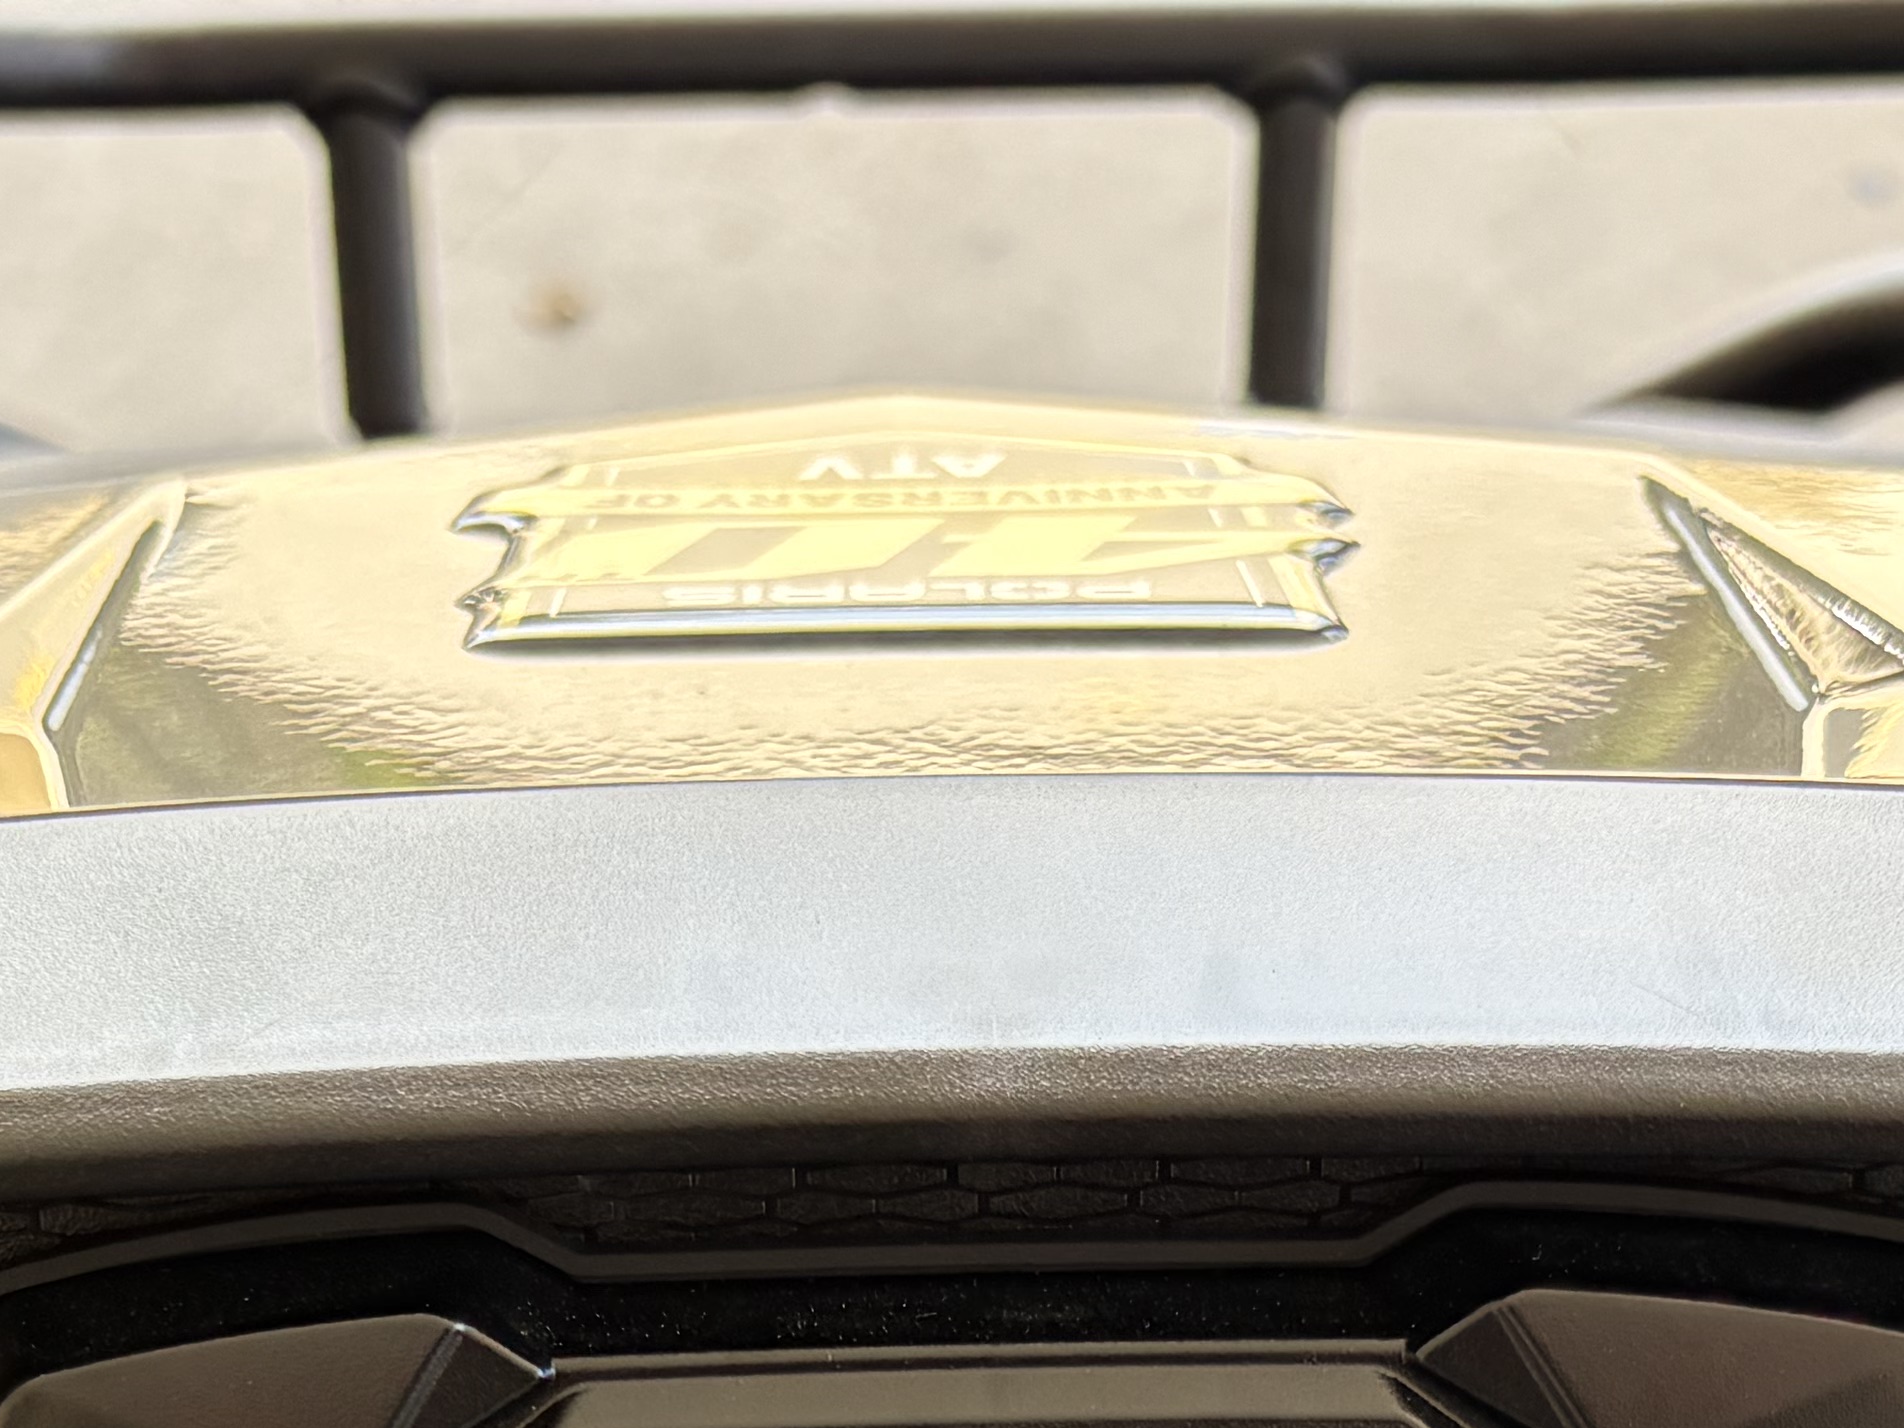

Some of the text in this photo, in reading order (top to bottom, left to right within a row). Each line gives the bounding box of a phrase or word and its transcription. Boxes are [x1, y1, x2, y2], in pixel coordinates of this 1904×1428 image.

[799, 451, 1007, 481] ATV
[592, 484, 1214, 510] ANNIVERSARY OF
[660, 578, 1154, 603] POLARIS
